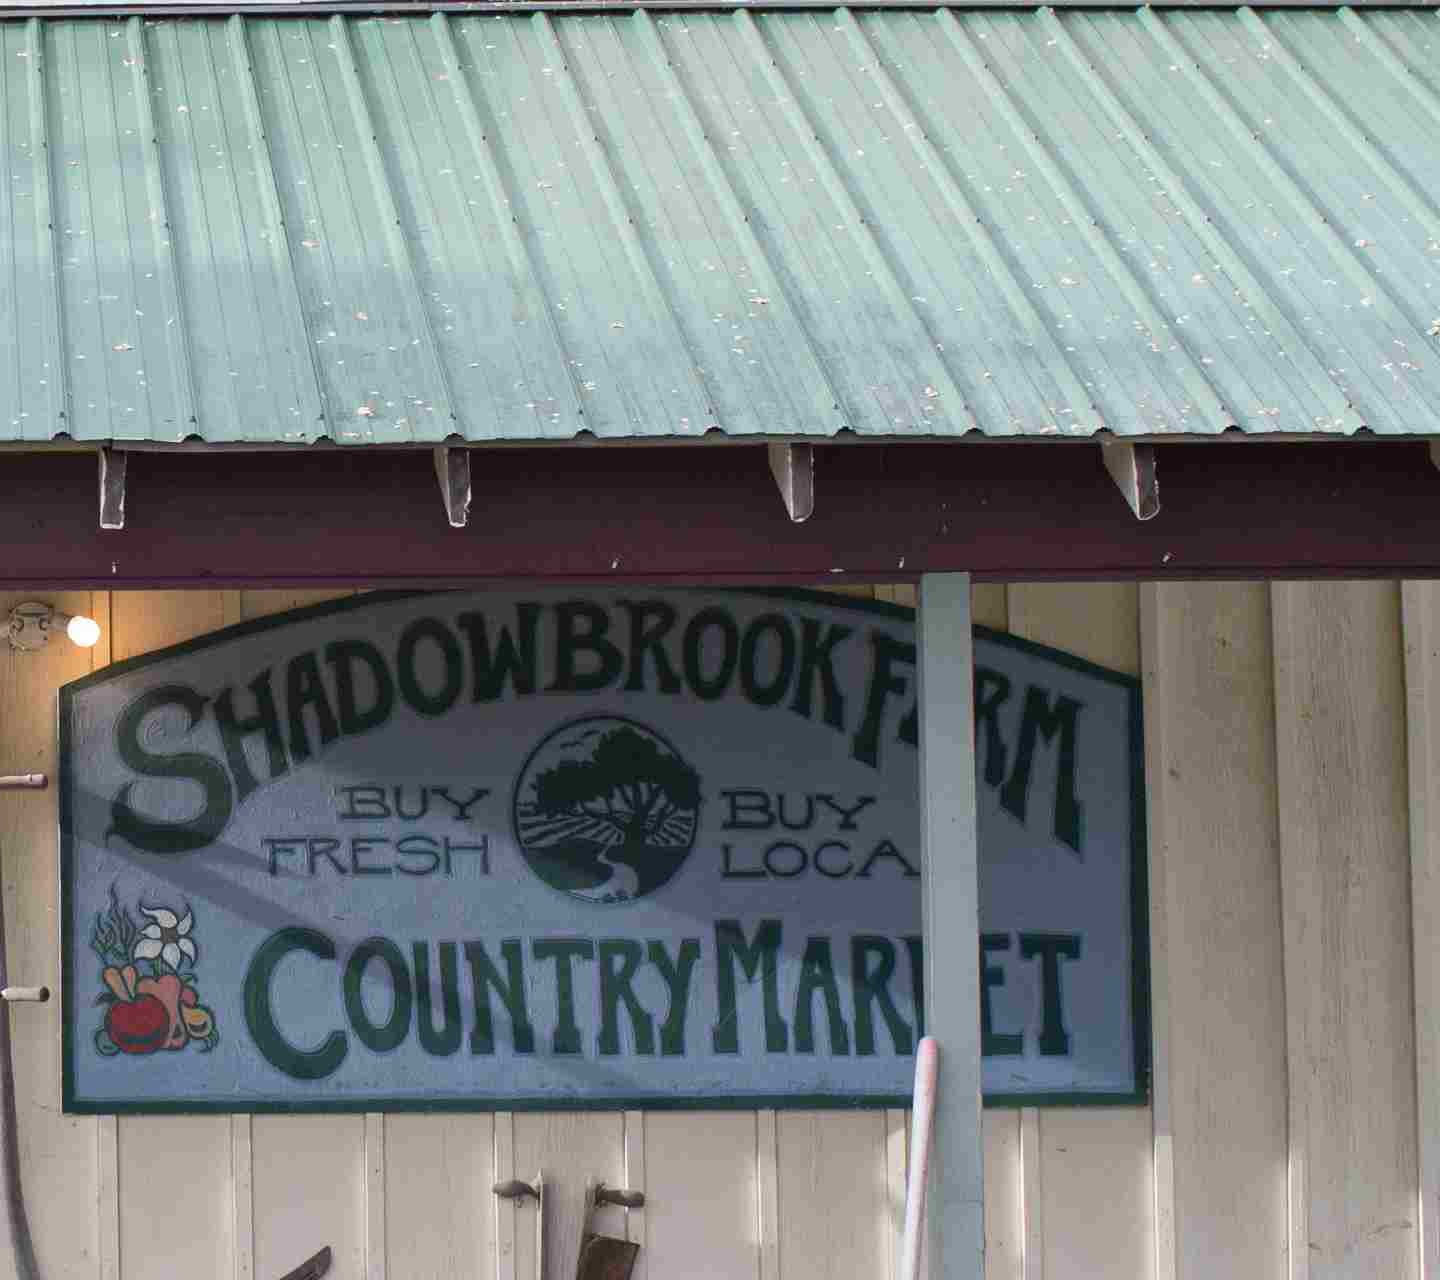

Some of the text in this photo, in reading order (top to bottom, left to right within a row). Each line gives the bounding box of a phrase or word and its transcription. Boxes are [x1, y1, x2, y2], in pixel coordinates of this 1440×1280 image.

[104, 598, 1086, 855] SHADOWBROOK FRM
[337, 785, 490, 821] BUY
[721, 787, 877, 830] BUY
[261, 832, 491, 876] FRESH
[721, 838, 922, 879] LOCA
[242, 926, 701, 1080] COUNTRY
